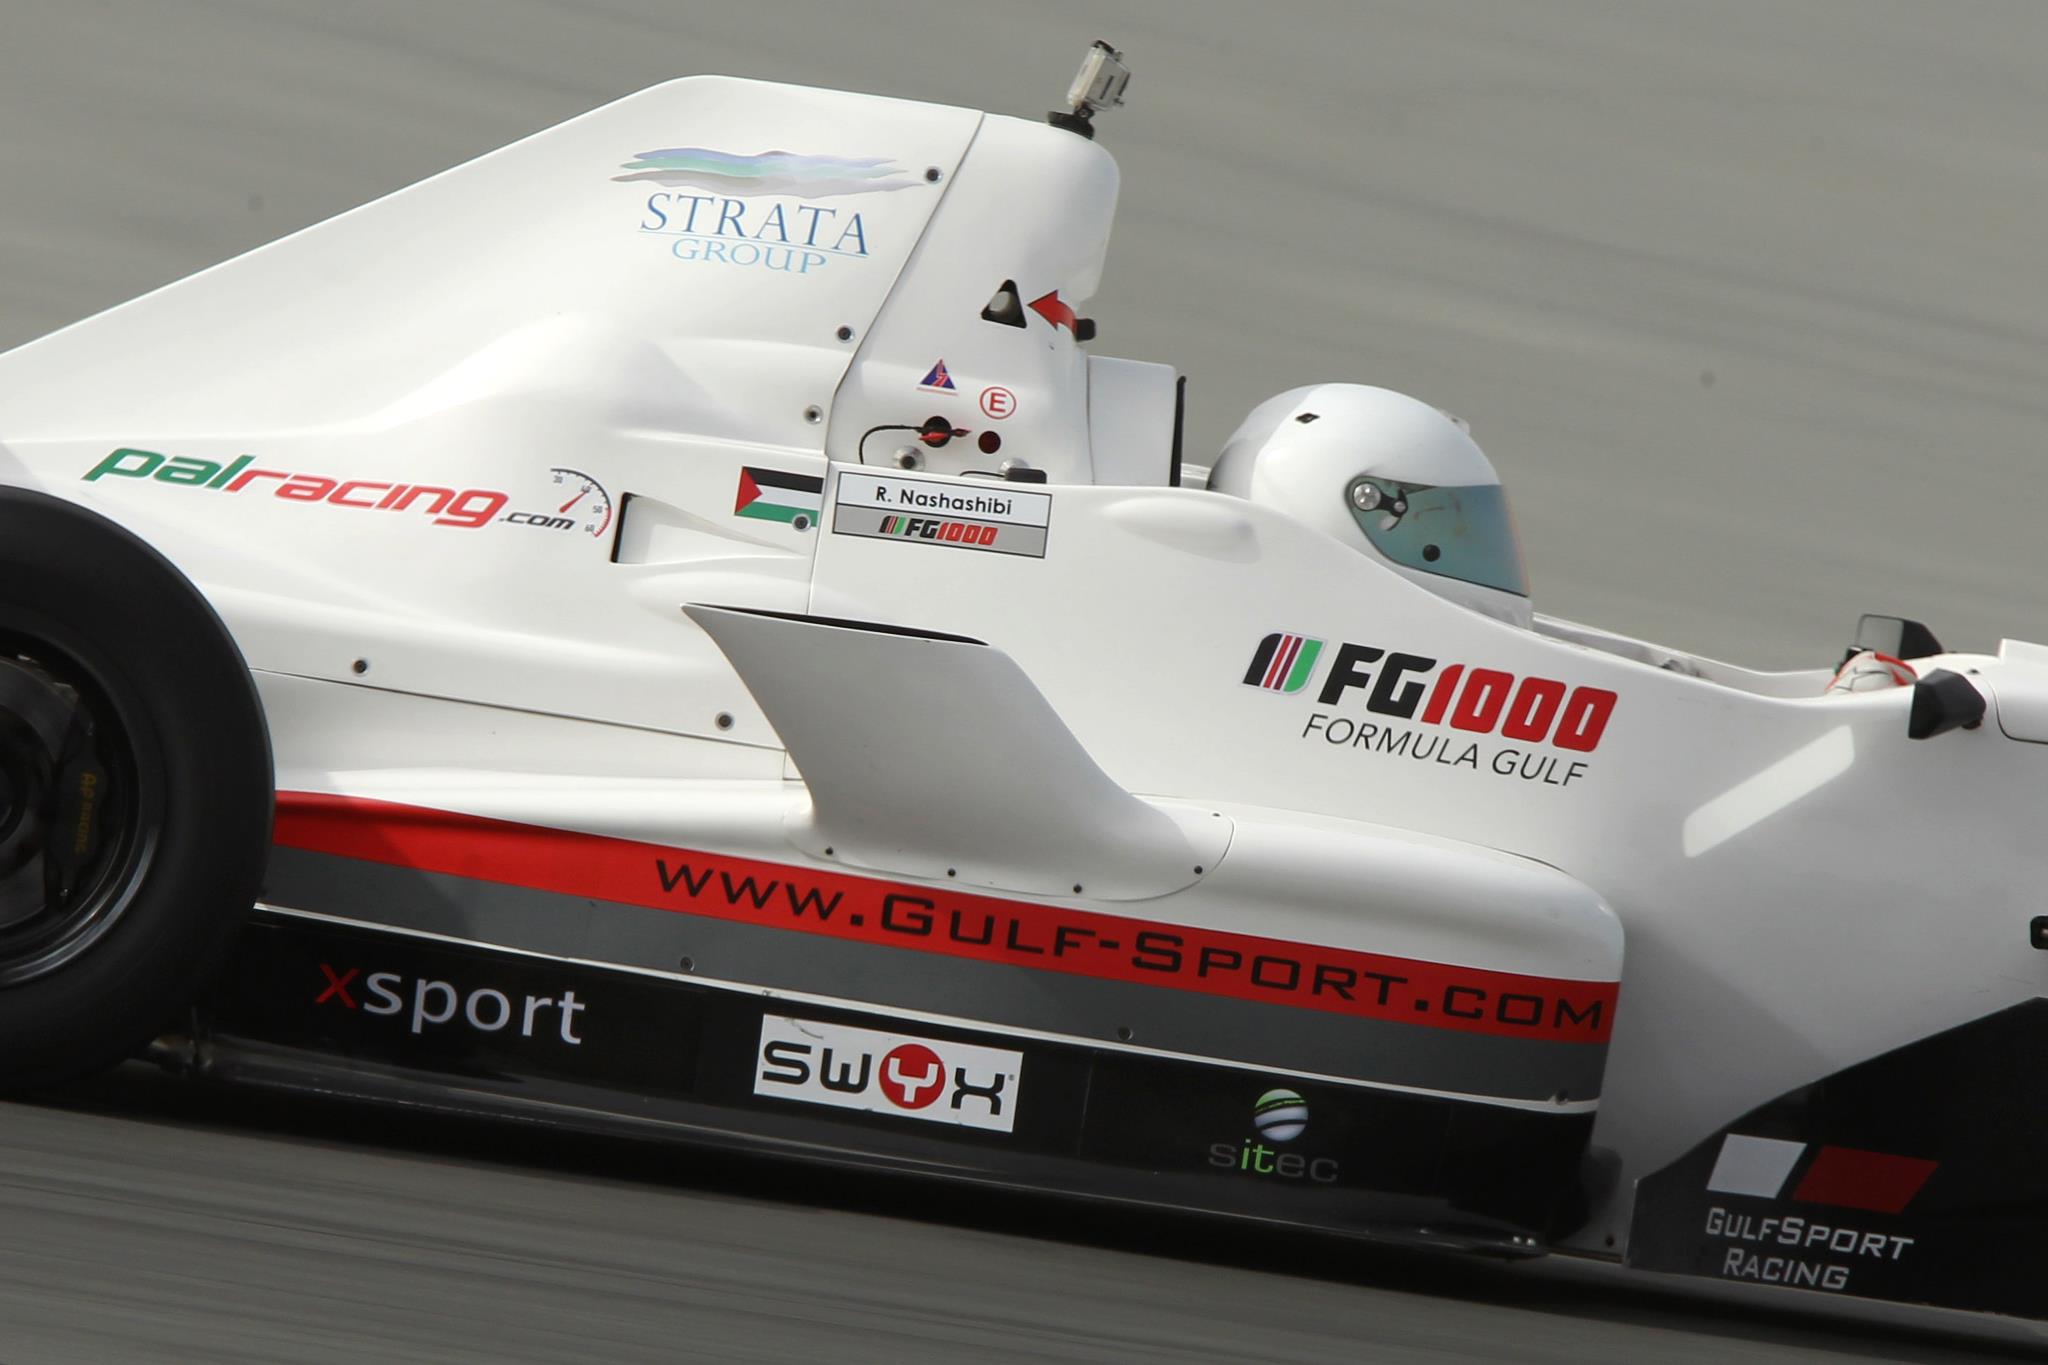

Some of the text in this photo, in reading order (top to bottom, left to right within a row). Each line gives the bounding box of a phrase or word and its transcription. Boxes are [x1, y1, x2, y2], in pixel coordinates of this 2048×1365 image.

[640, 192, 869, 256] STRATA
[672, 238, 827, 274] GROUP
[989, 391, 1007, 413] E
[876, 486, 1012, 515] R. Nashashibi
[904, 517, 998, 546] FG1000
[1317, 641, 1618, 753] FG1000
[1301, 712, 1589, 787] FORMULA GULF
[315, 963, 586, 1045] xsport
[1208, 1138, 1339, 1183] sitec
